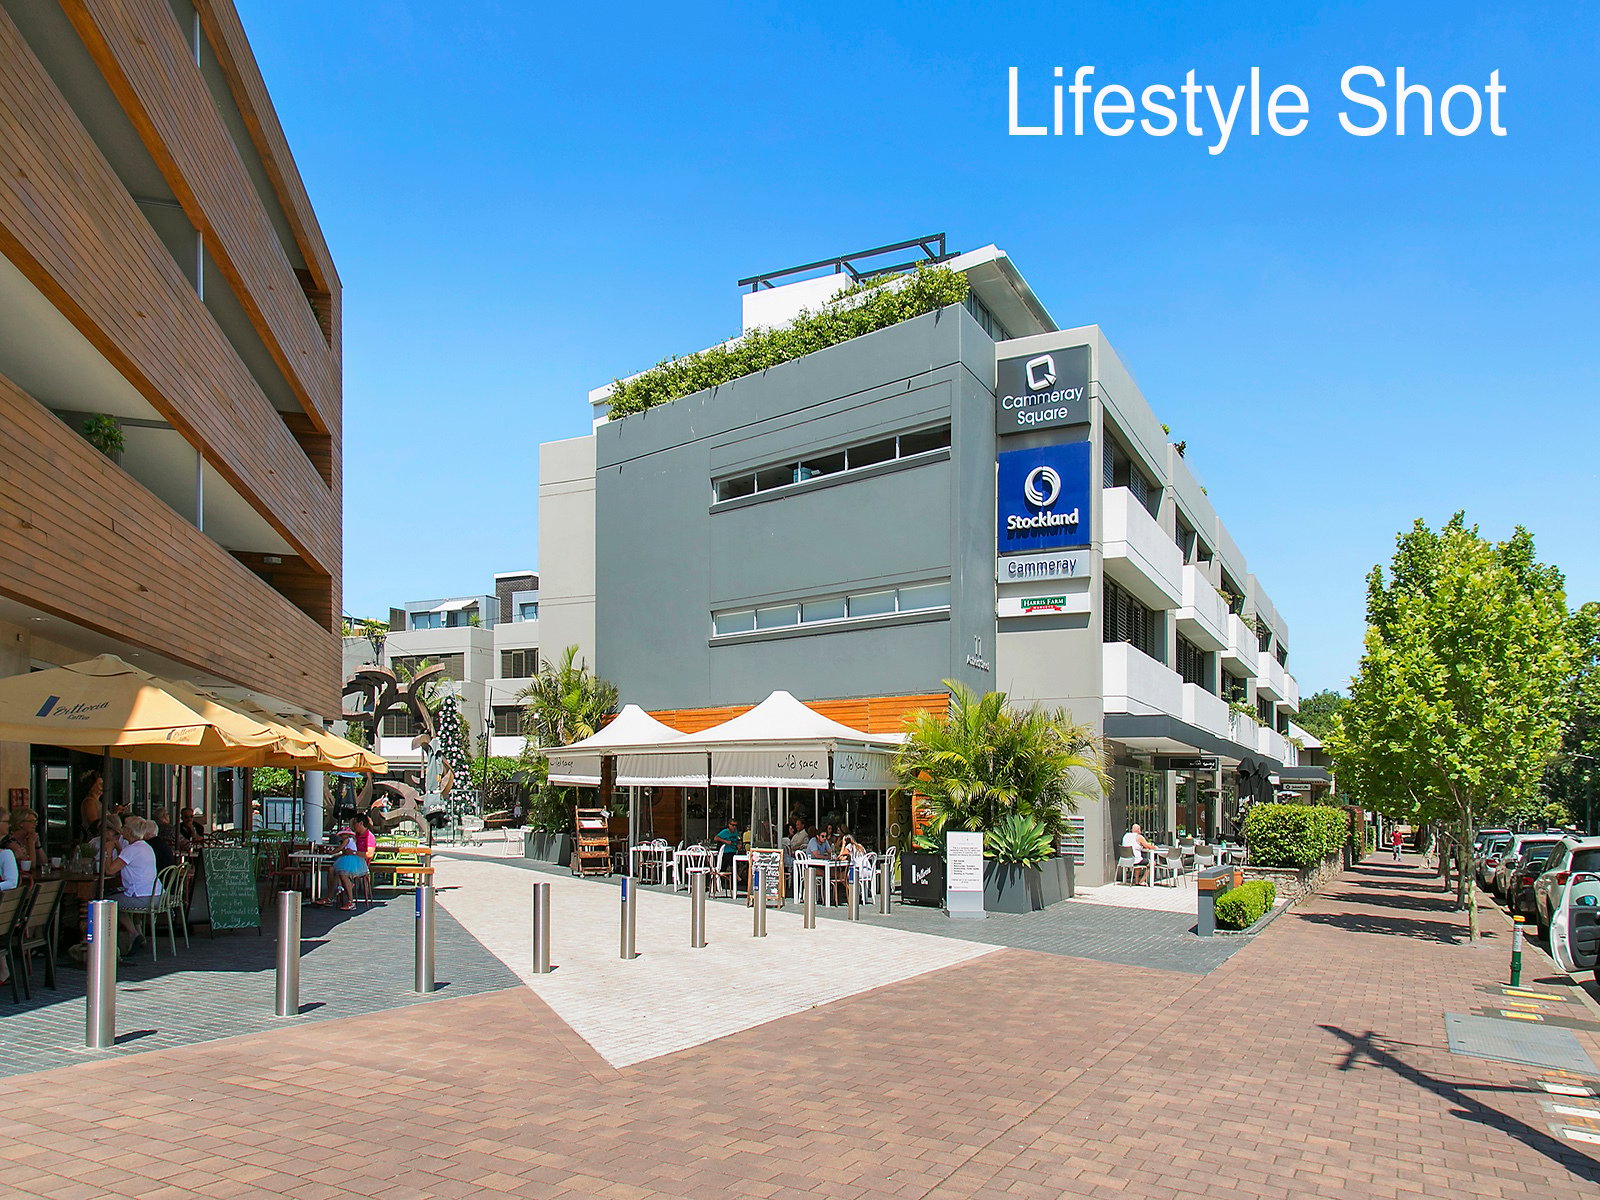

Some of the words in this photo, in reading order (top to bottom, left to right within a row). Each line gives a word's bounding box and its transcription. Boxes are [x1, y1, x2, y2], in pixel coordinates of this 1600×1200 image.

[1002, 387, 1083, 409] Cammeray
[1017, 407, 1068, 425] Square
[1007, 507, 1079, 530] Stockland
[1008, 558, 1077, 576] Cammeray
[777, 754, 796, 770] wild
[798, 759, 819, 778] sage
